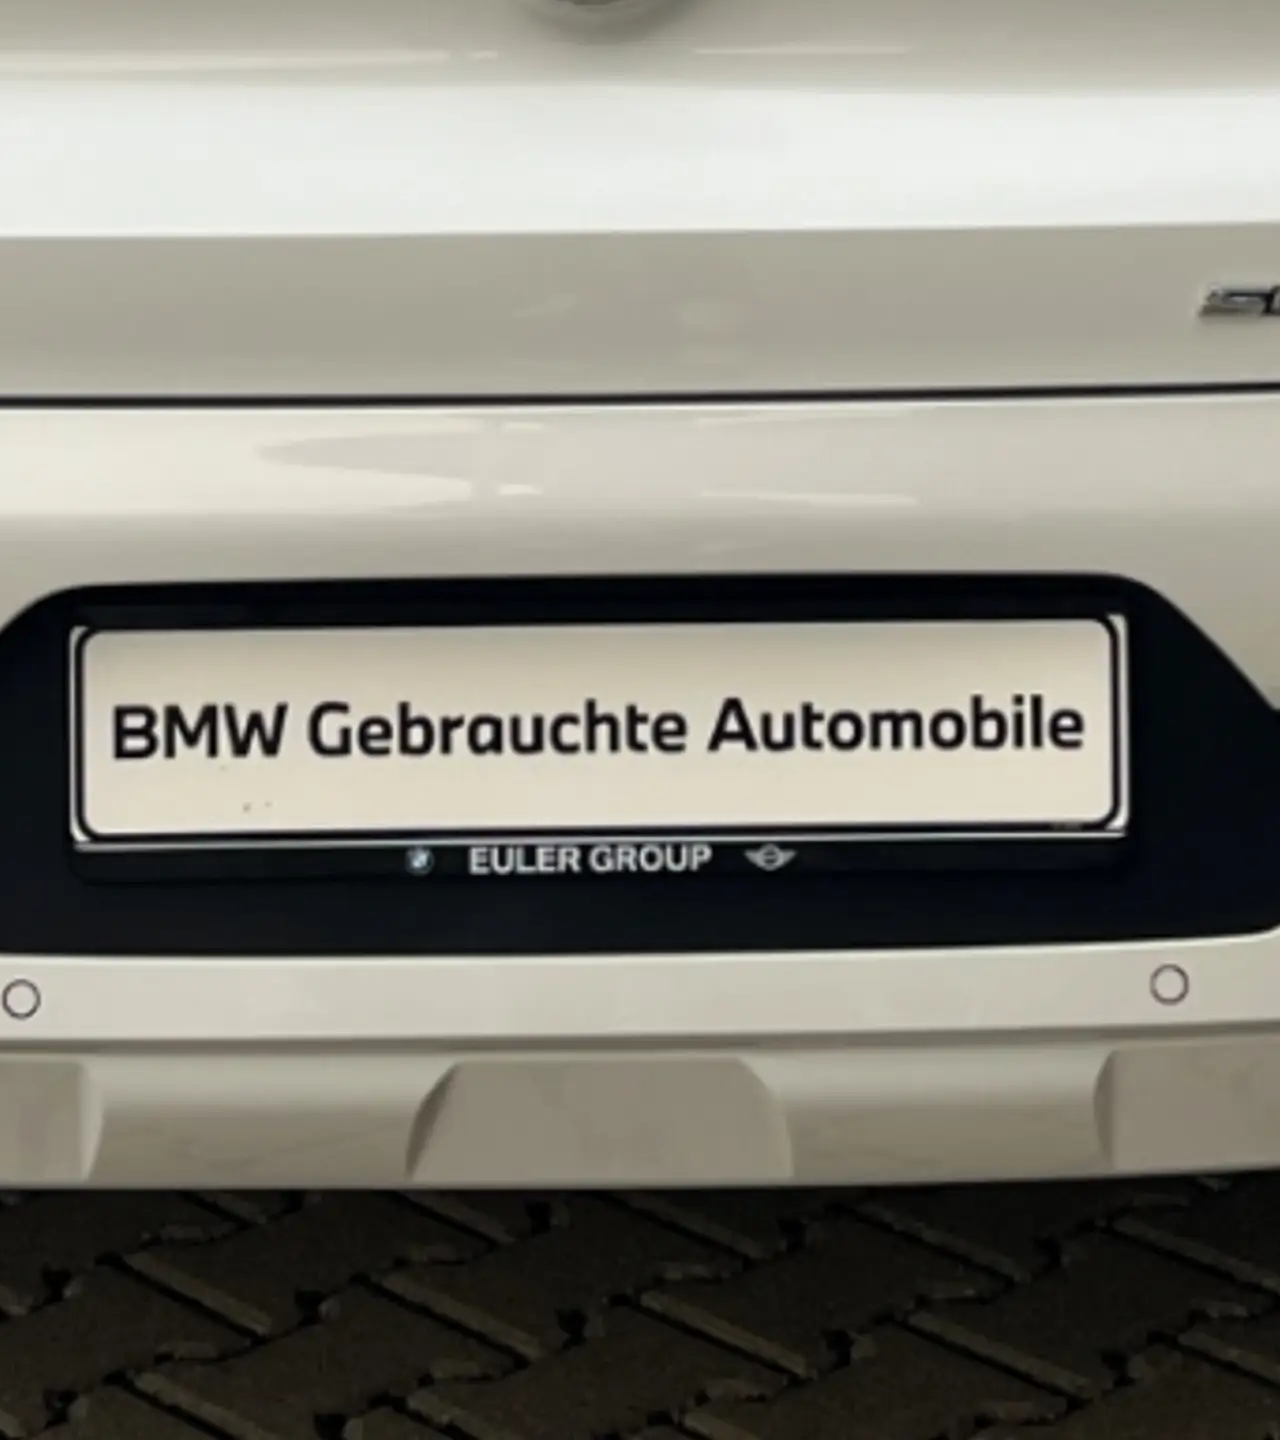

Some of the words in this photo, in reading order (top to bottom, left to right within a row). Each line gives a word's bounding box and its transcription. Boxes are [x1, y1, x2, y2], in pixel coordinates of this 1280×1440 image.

[113, 702, 288, 760] BMW
[307, 698, 687, 758] Gebrauchte
[707, 694, 1086, 752] Automobile
[468, 846, 581, 875] EULER
[588, 844, 713, 873] GROUP
